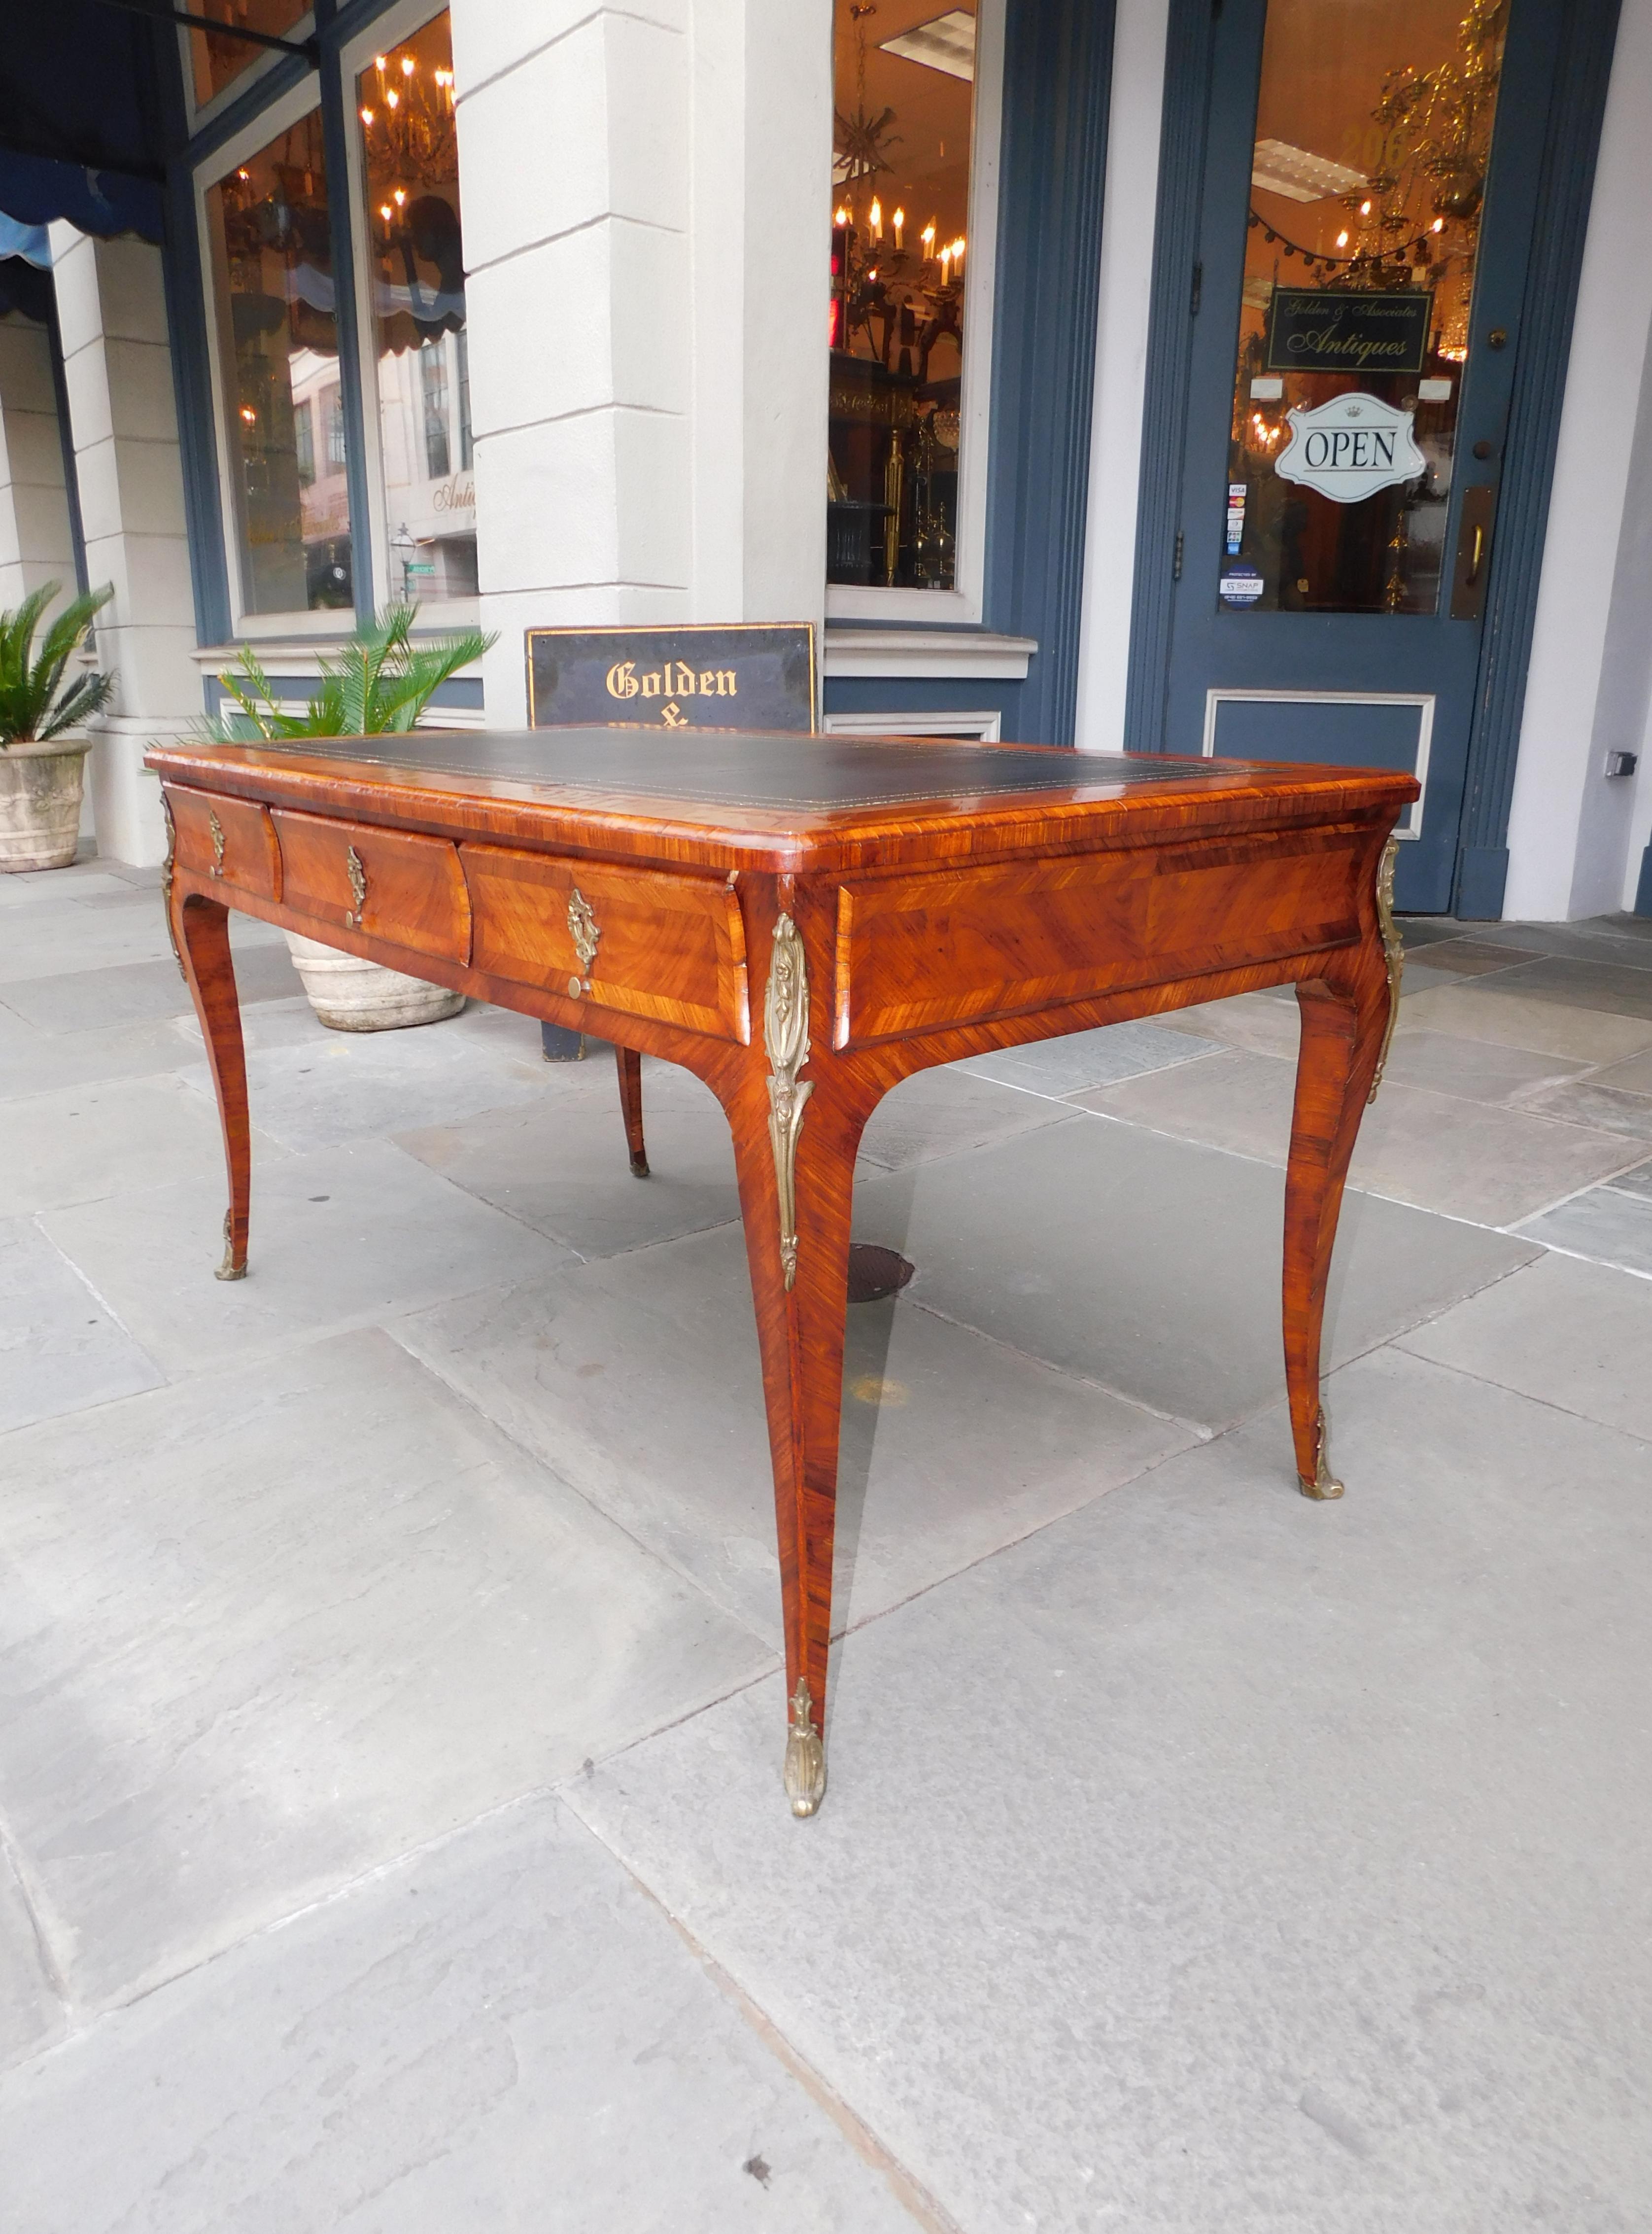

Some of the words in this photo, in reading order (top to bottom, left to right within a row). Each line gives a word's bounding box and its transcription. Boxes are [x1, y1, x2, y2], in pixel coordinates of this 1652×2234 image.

[1340, 124, 1406, 169] 206
[1284, 298, 1329, 317] Golden
[1333, 303, 1348, 321] &
[1352, 301, 1417, 317] Associates
[1287, 323, 1408, 365] Antiques
[1305, 432, 1397, 467] OPEN
[606, 661, 737, 699] Golden
[661, 701, 688, 727] &
